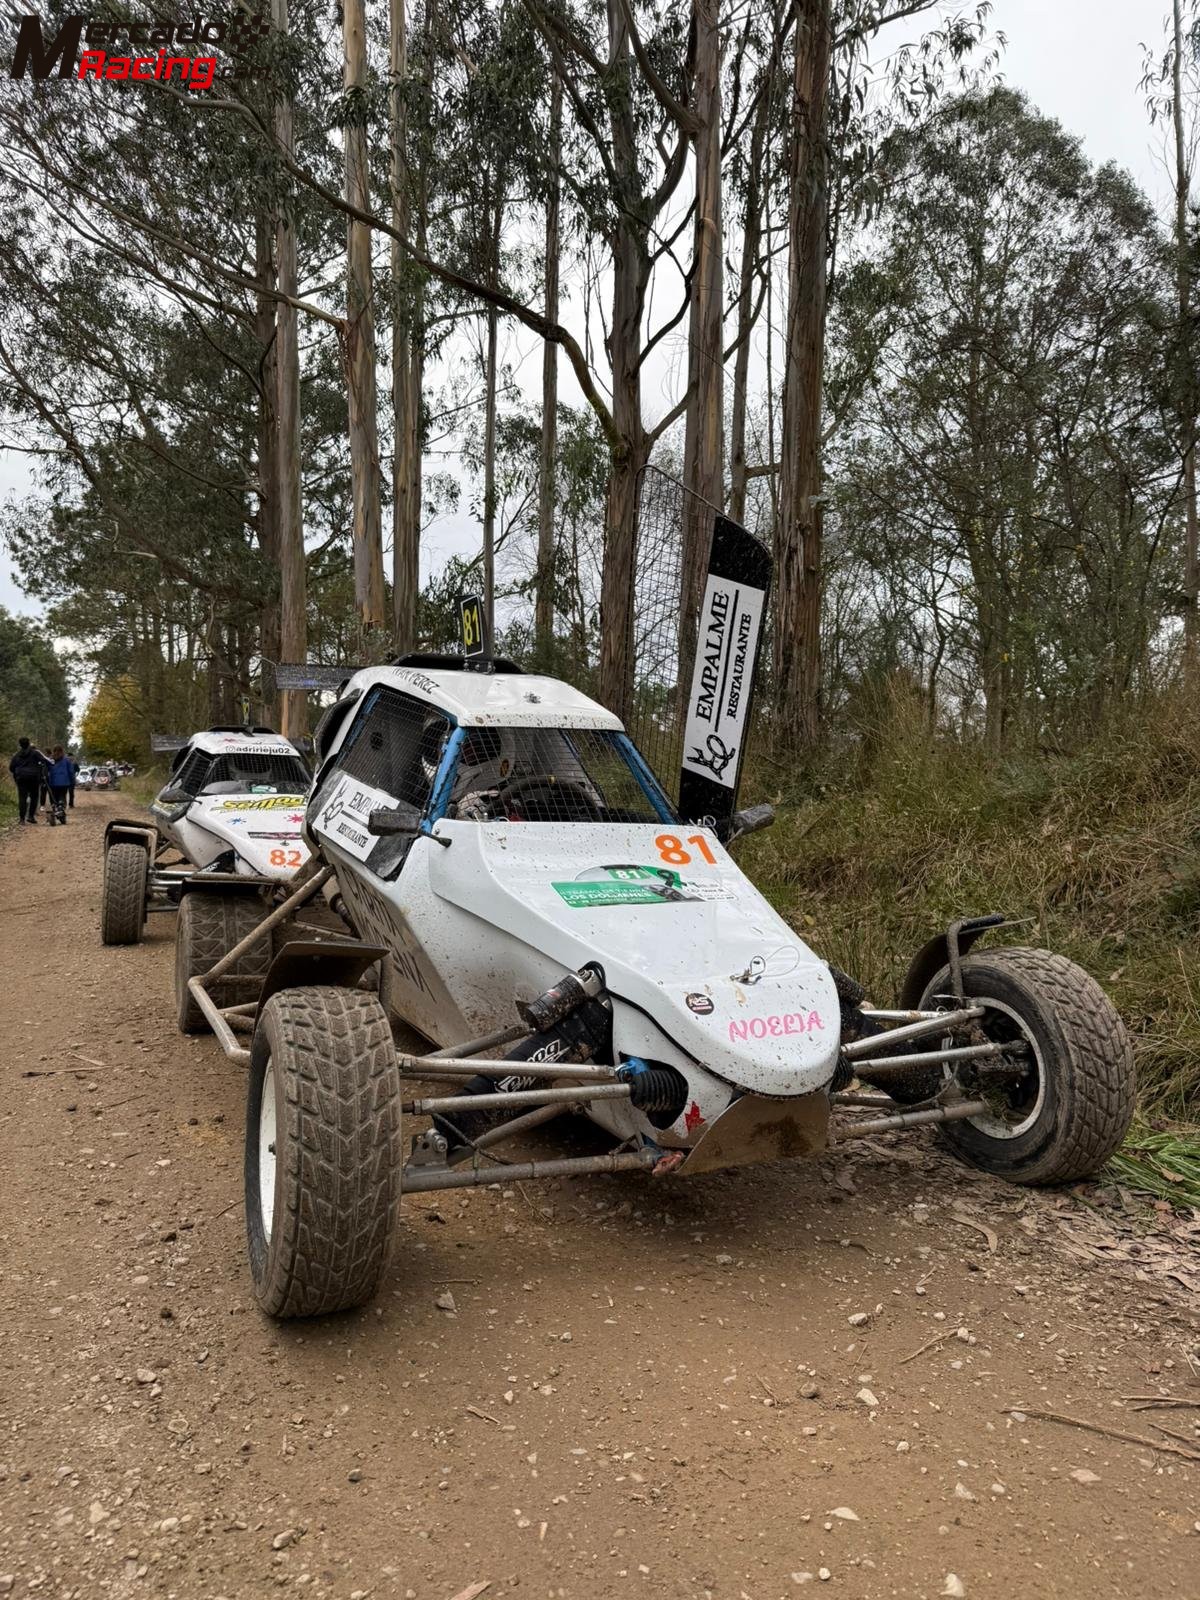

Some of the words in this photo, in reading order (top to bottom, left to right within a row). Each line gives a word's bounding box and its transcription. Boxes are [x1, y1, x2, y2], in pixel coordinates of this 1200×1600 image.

[464, 605, 480, 646] 81
[695, 590, 730, 724] EMPALME
[726, 612, 752, 719] RESTAURANTE
[269, 849, 302, 868] 82
[655, 834, 718, 865] 81
[616, 869, 641, 879] 81
[729, 1010, 825, 1043] NOELIA
